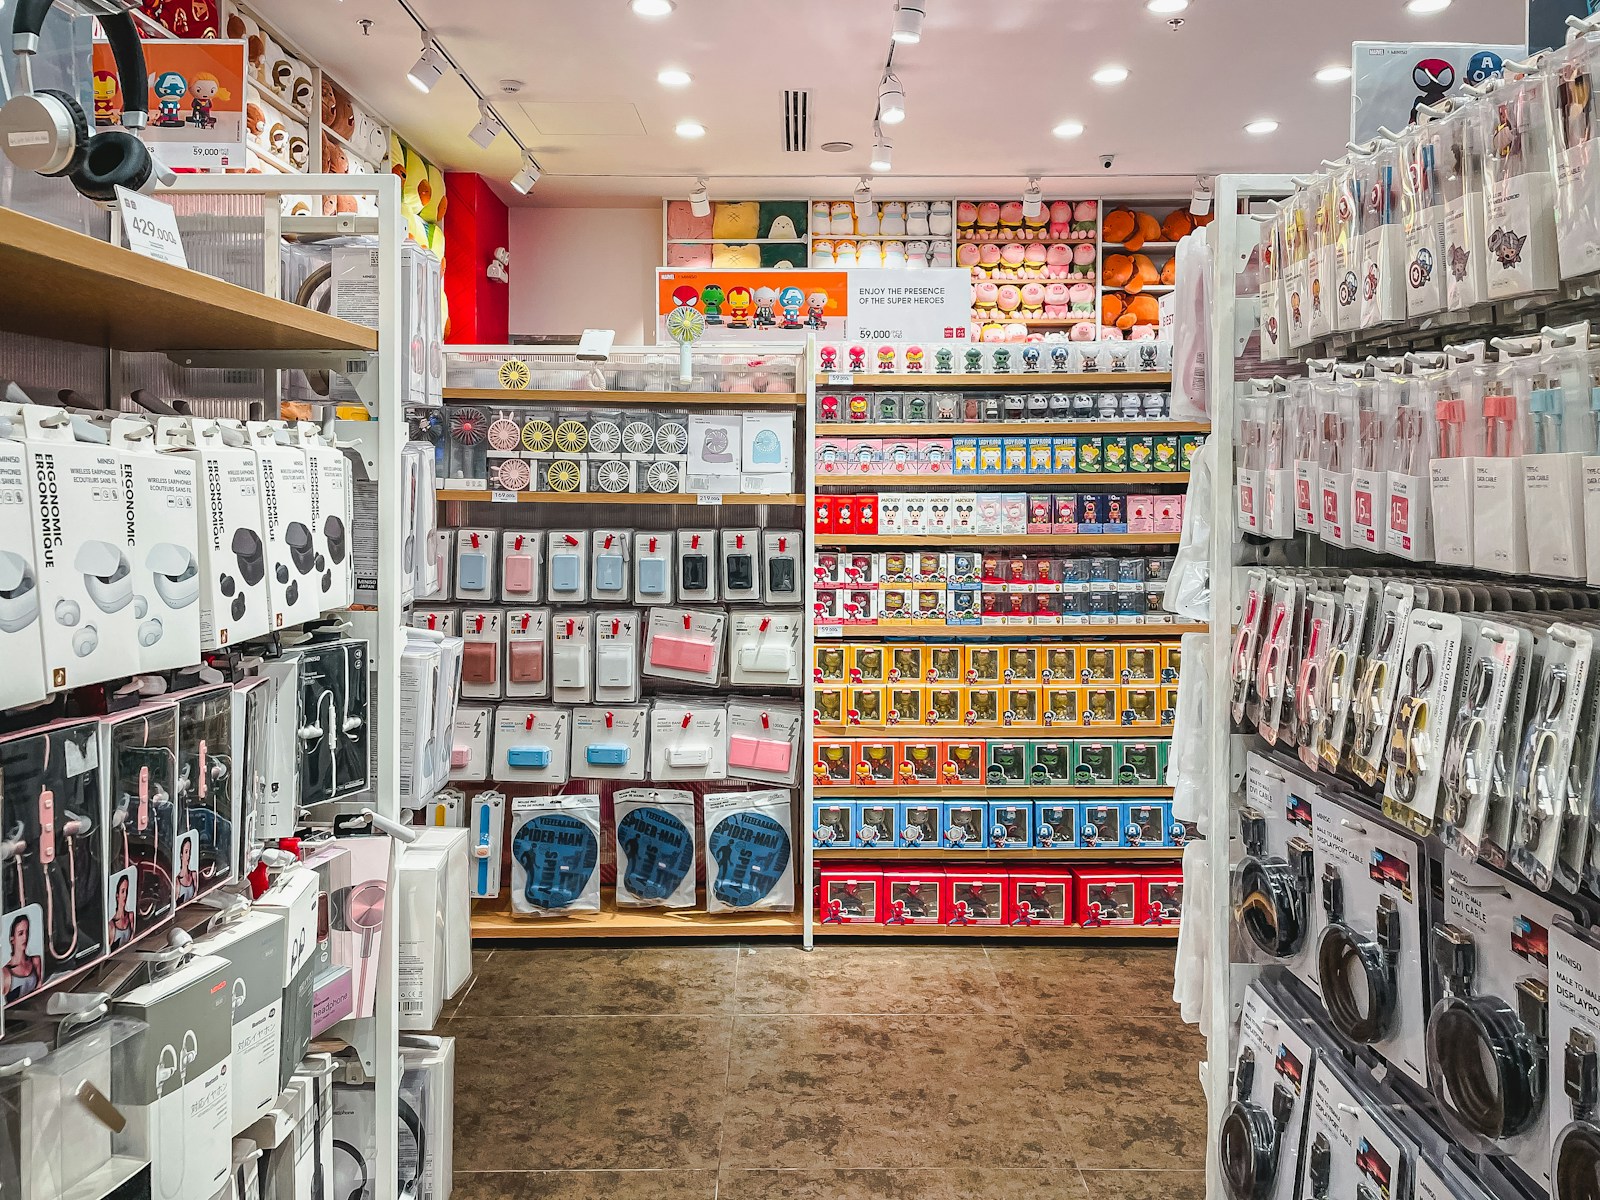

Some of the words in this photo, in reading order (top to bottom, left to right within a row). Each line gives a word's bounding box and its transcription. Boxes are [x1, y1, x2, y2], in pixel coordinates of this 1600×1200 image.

[193, 148, 219, 156] 59,000
[860, 330, 890, 339] 59,000
[45, 454, 62, 546] ERGONOMIC
[124, 464, 135, 546] ERGONOMIC
[207, 460, 220, 552] ERGONOMIQUE
[213, 460, 224, 534] ERGONOMIC
[262, 460, 276, 542] ERGONOMIQUE
[267, 460, 279, 526] ERGONOMIC
[35, 454, 54, 568] ERGONOMIQUE
[1357, 497, 1370, 518] 15cm
[1393, 502, 1407, 524] 15cm
[1446, 640, 1454, 670] MICRO
[1502, 656, 1511, 688] MICRO
[1575, 661, 1584, 696] MICRO
[1250, 766, 1261, 776] MINISO
[1250, 786, 1258, 794] DVI
[1259, 790, 1272, 802] CABLE
[622, 816, 682, 848] SPIDER-MAN
[1317, 812, 1332, 824] MINISO
[516, 826, 583, 847] SPIDER-MAN
[714, 820, 779, 849] SPIDER-MAN
[1317, 826, 1326, 835] MALE
[1333, 833, 1344, 843] MALE
[1317, 836, 1349, 857] DISPLAYPORT
[1349, 850, 1364, 864] CABLE
[1450, 869, 1468, 884] MINISO
[1450, 885, 1464, 896] MALE
[1464, 892, 1471, 900] TO
[1471, 895, 1482, 907] MALE
[1450, 896, 1464, 910] DVI
[1466, 903, 1487, 924] CABLE
[1556, 951, 1582, 971] MINISO
[1556, 971, 1573, 986] MALE
[1574, 981, 1583, 991] TO
[1585, 988, 1600, 1002] MALE
[314, 993, 348, 1018] headphone
[1316, 1100, 1339, 1131] DISPLAYPORT
[1340, 1129, 1352, 1147] CABLE
